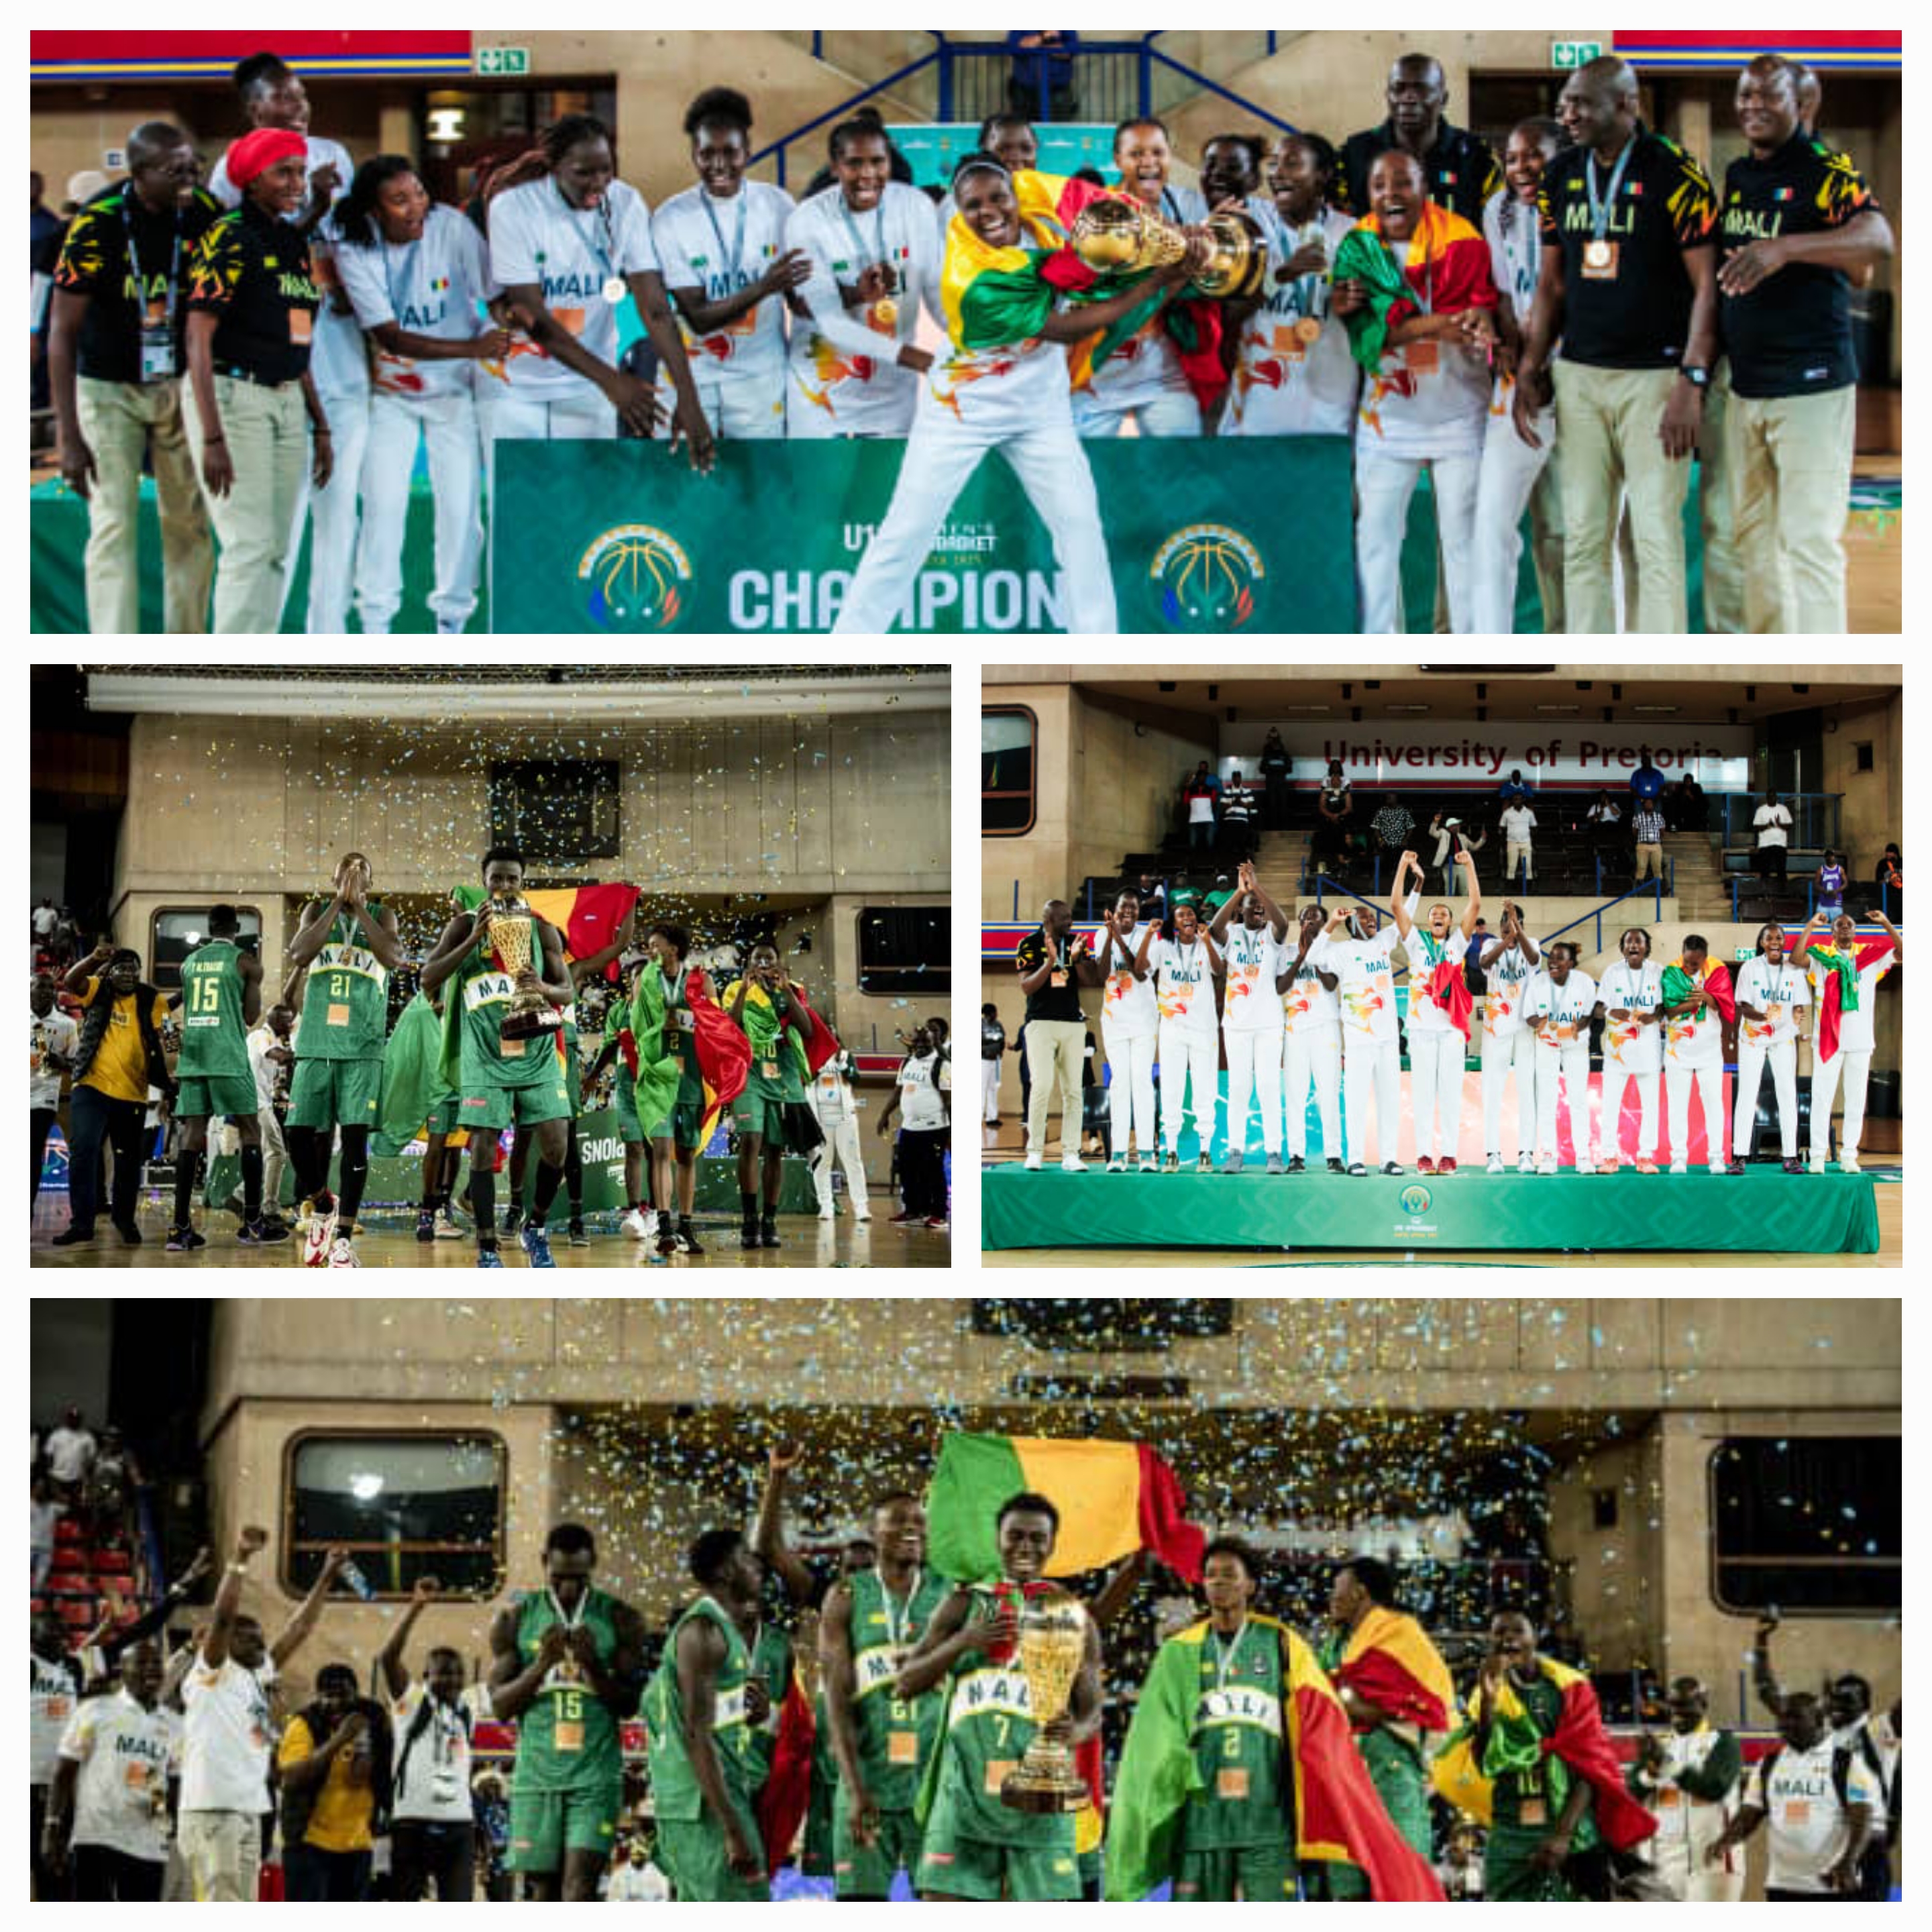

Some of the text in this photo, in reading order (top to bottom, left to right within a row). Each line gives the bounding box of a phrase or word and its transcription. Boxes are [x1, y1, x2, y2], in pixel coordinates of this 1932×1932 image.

[277, 272, 322, 301] MAL
[543, 272, 604, 298] MALI
[402, 300, 445, 327] ALI
[1324, 739, 1507, 775] University
[1525, 739, 1562, 767] of
[1364, 959, 1389, 973] MAL
[192, 977, 218, 1012] 15
[331, 975, 350, 998] 21
[478, 979, 510, 998] MA
[1623, 995, 1654, 1008] MALI
[581, 1136, 626, 1165] PIONS
[554, 1690, 582, 1720] 15
[994, 1714, 1010, 1748] 7
[1774, 1778, 1825, 1796] MALI
